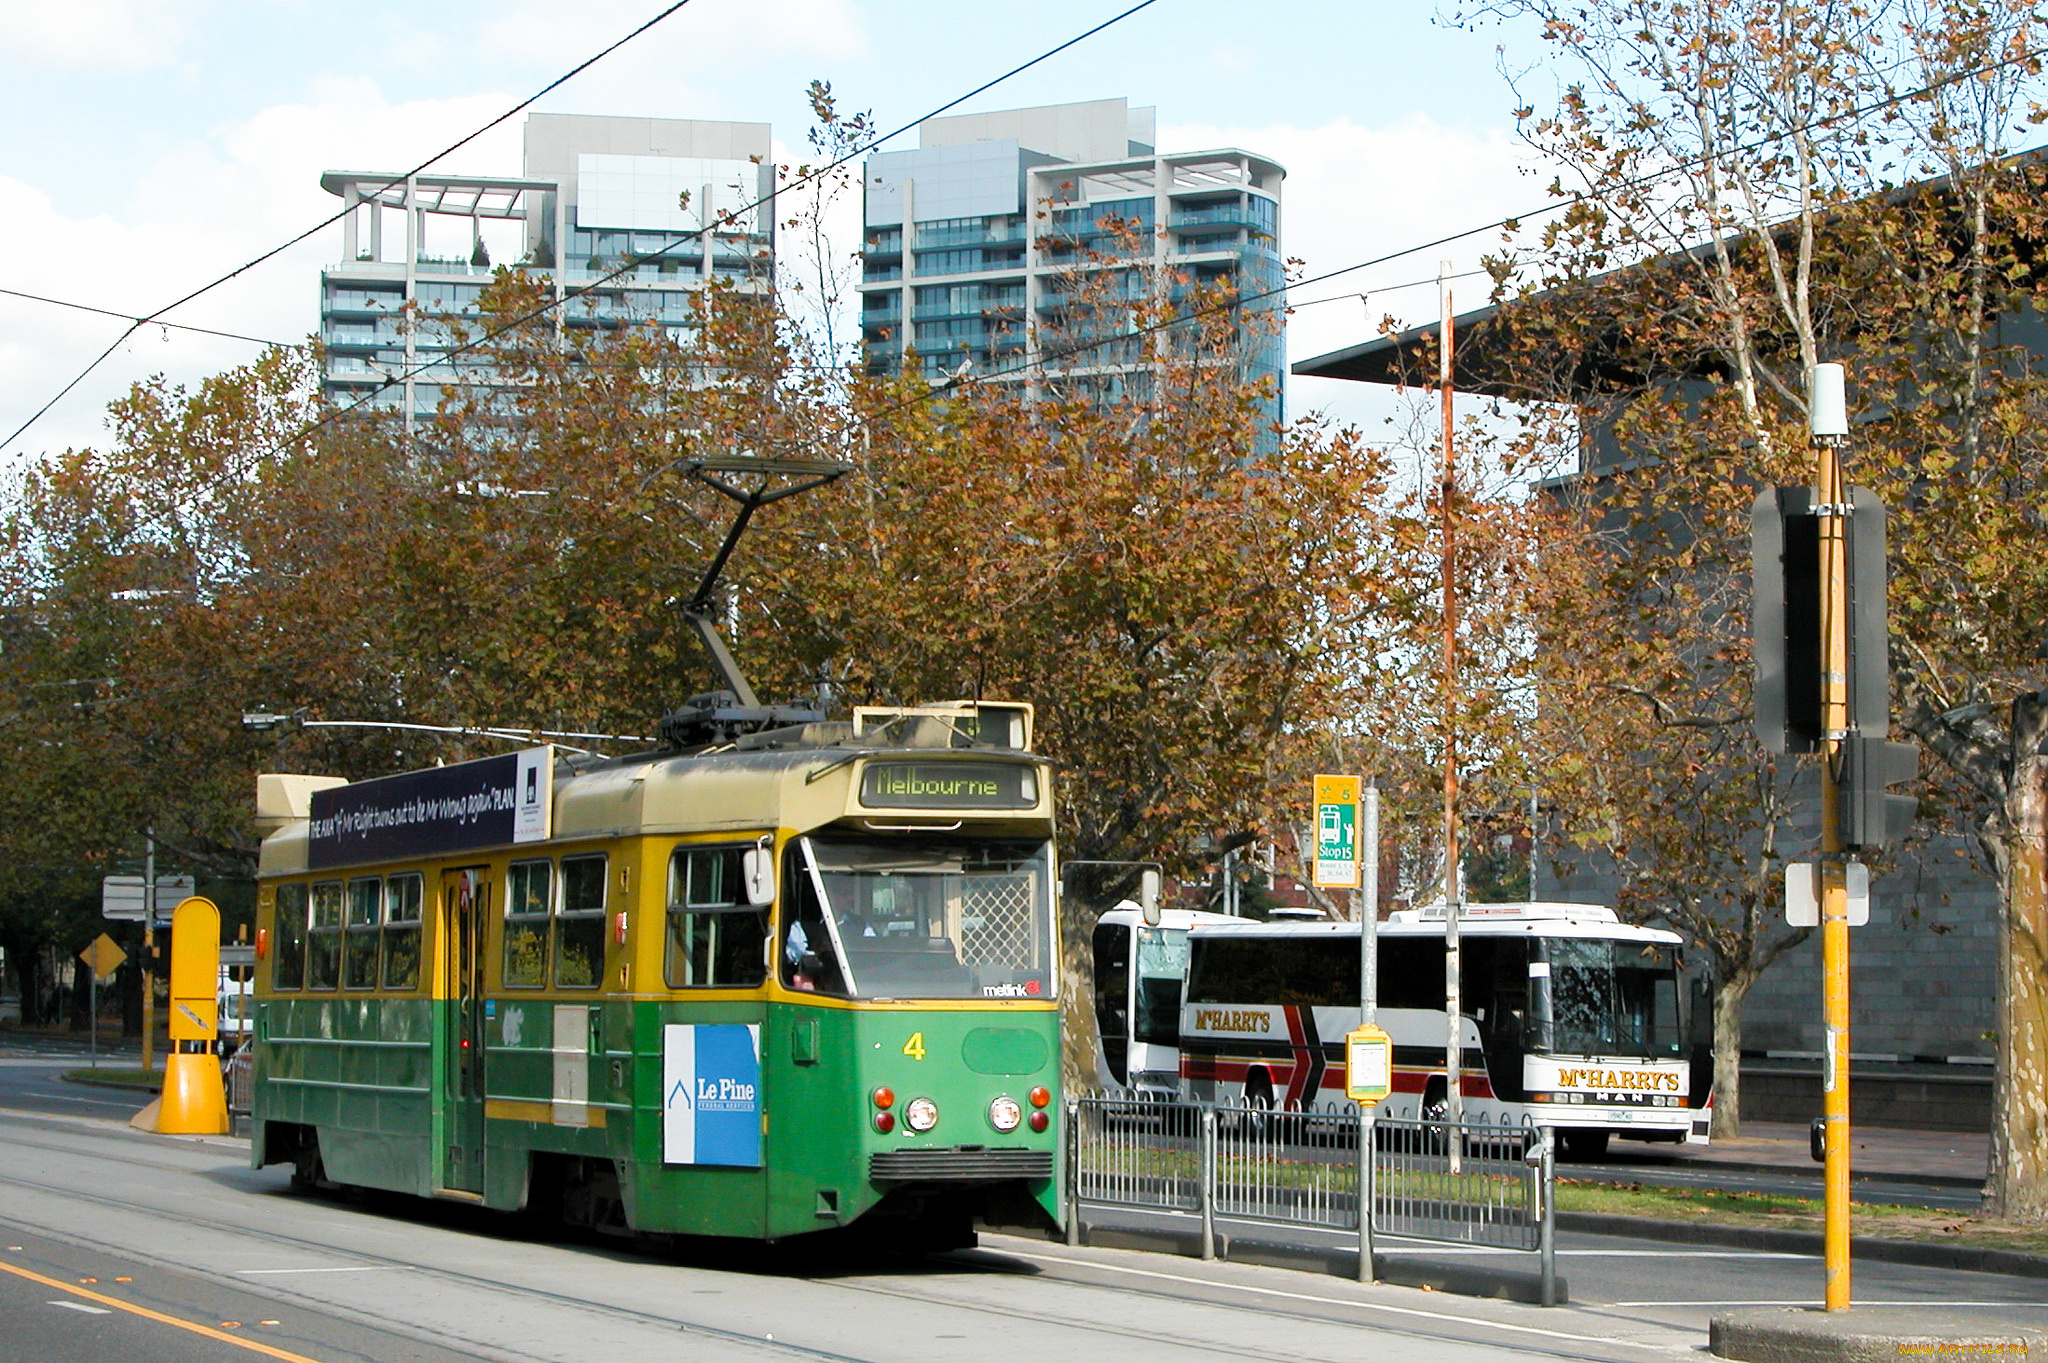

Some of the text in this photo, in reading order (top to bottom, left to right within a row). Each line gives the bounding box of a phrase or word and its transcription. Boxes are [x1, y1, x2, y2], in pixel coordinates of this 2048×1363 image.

[876, 766, 998, 796] Melbourne
[1342, 789, 1351, 801] 5
[1319, 845, 1353, 860] Stop 15
[983, 984, 1028, 997] metlink
[903, 1031, 926, 1061] 4
[698, 1078, 755, 1100] Le Pine
[1595, 1092, 1645, 1102] MAN
